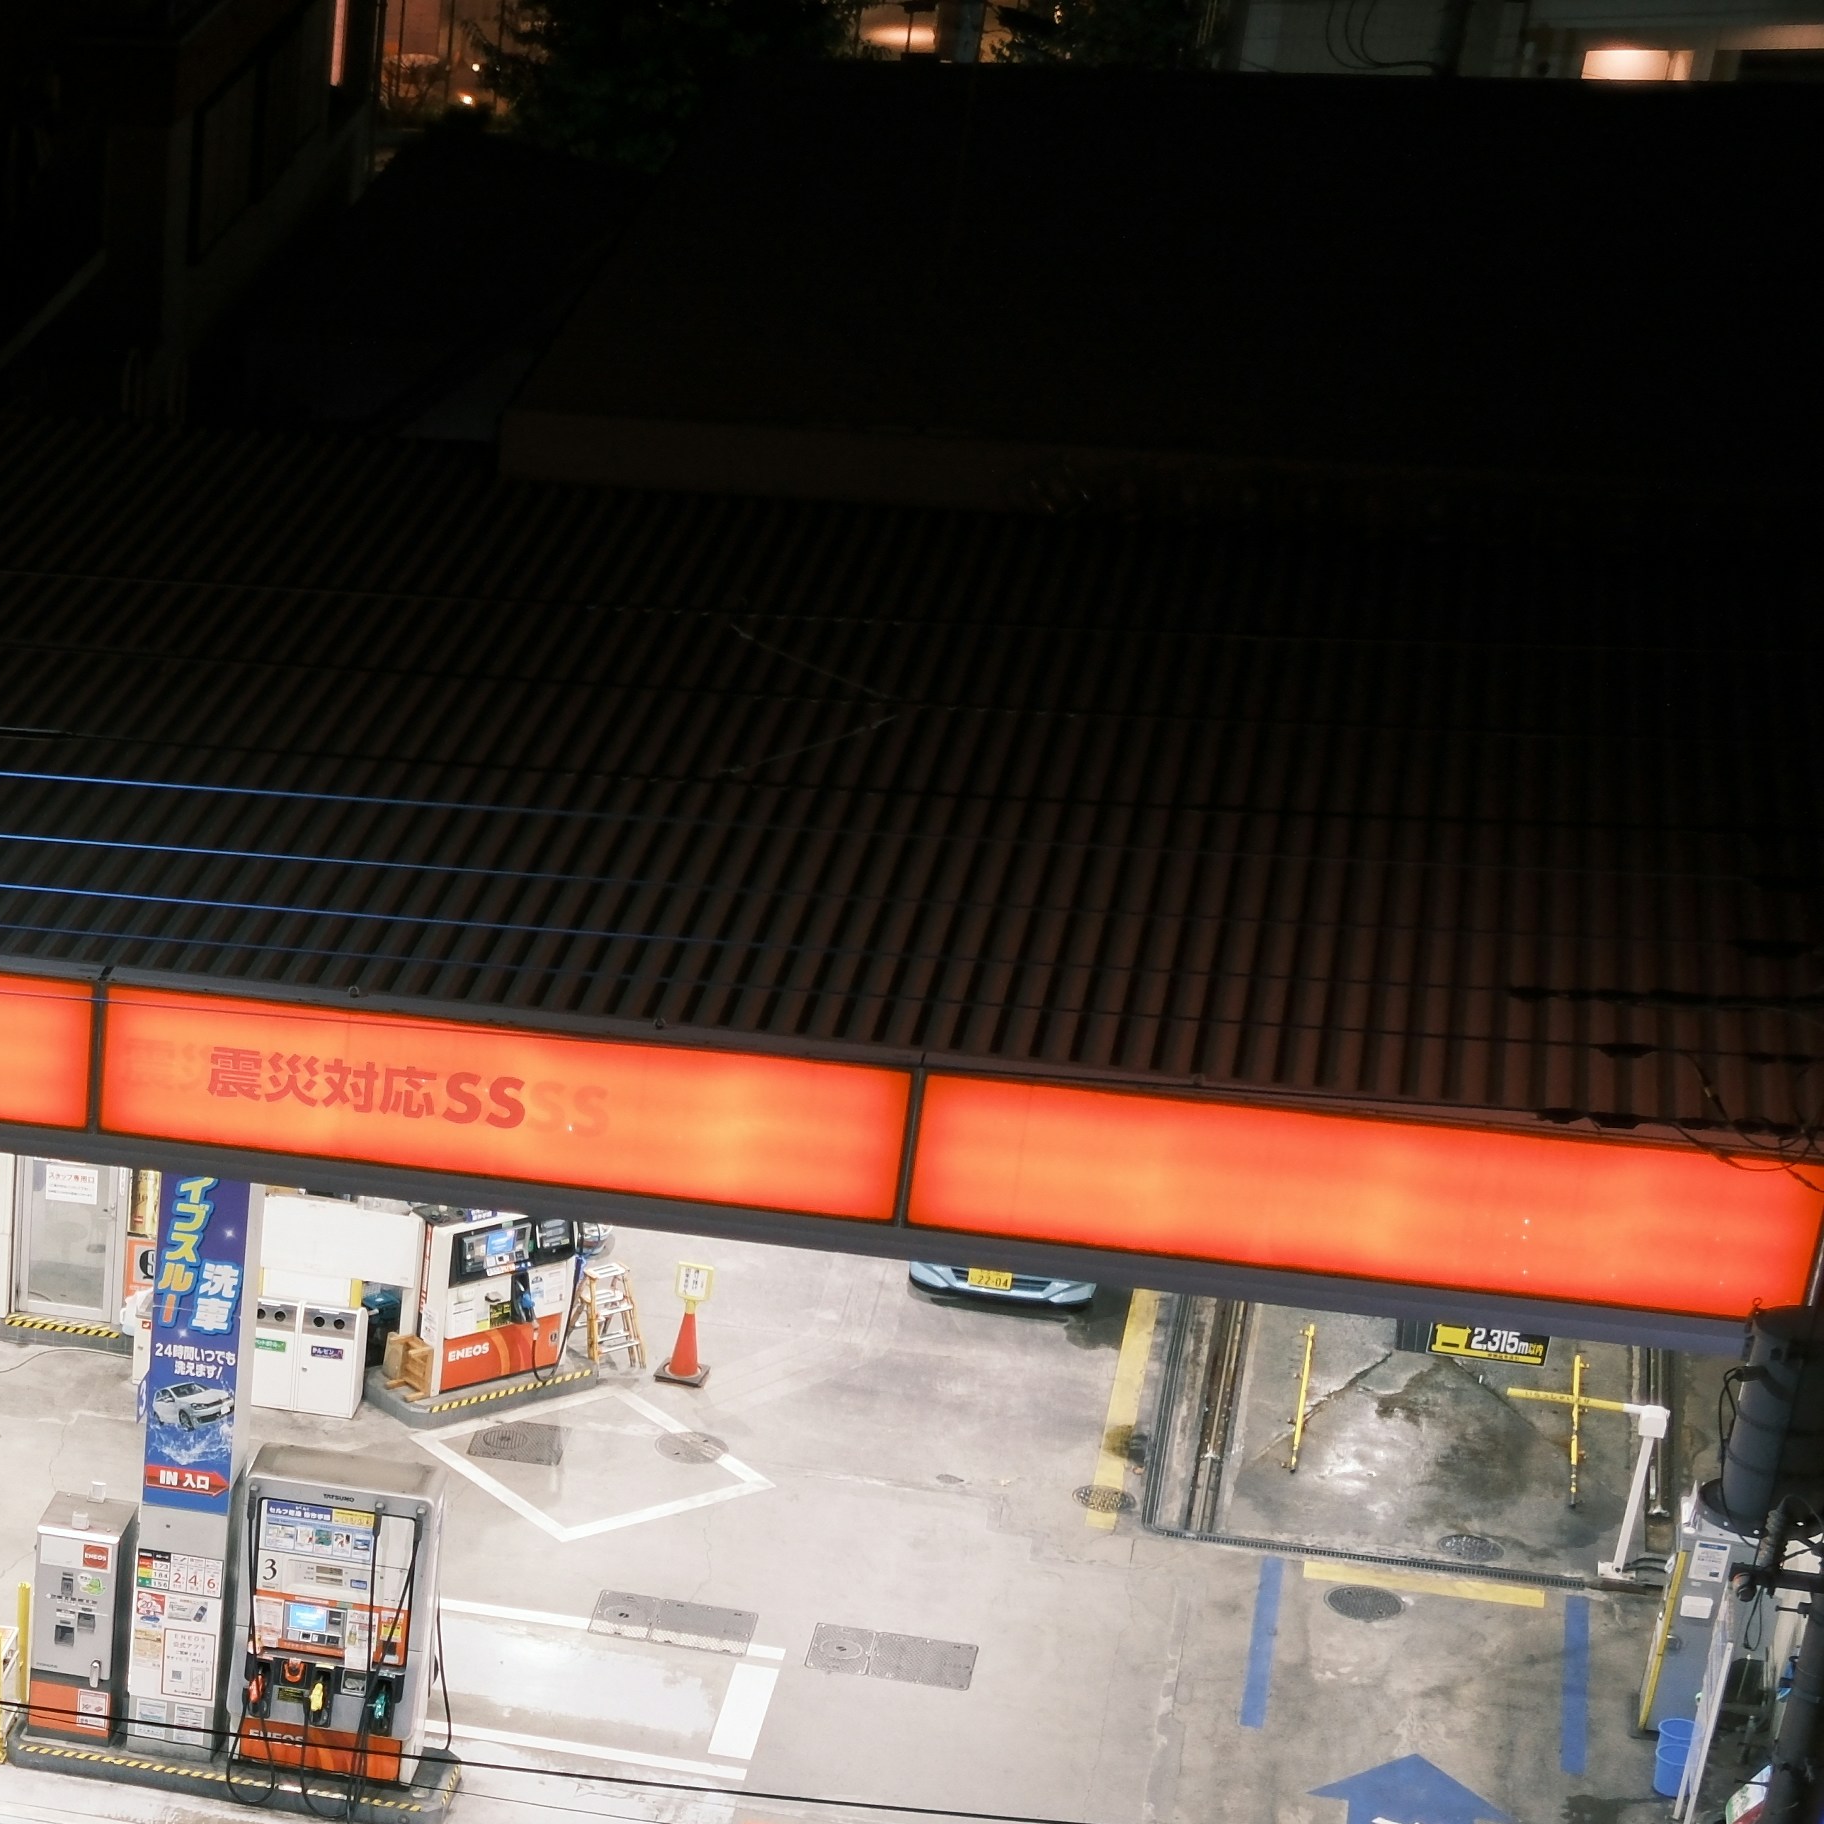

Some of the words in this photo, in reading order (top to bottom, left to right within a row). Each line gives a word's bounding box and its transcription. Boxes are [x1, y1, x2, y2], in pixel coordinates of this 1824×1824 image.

[208, 1045, 526, 1129] 震災対応SS
[192, 1263, 239, 1331] 洗車
[155, 1343, 236, 1366] 24時間いつでも
[447, 1342, 490, 1363] ENEOS
[138, 1379, 147, 1416] 3
[159, 1469, 178, 1486] IN
[183, 1472, 210, 1490] 入口
[84, 1552, 107, 1562] ENEOS
[173, 1572, 181, 1584] 2
[262, 1558, 277, 1581] 3
[188, 1574, 198, 1587] 4
[207, 1578, 216, 1589] 6
